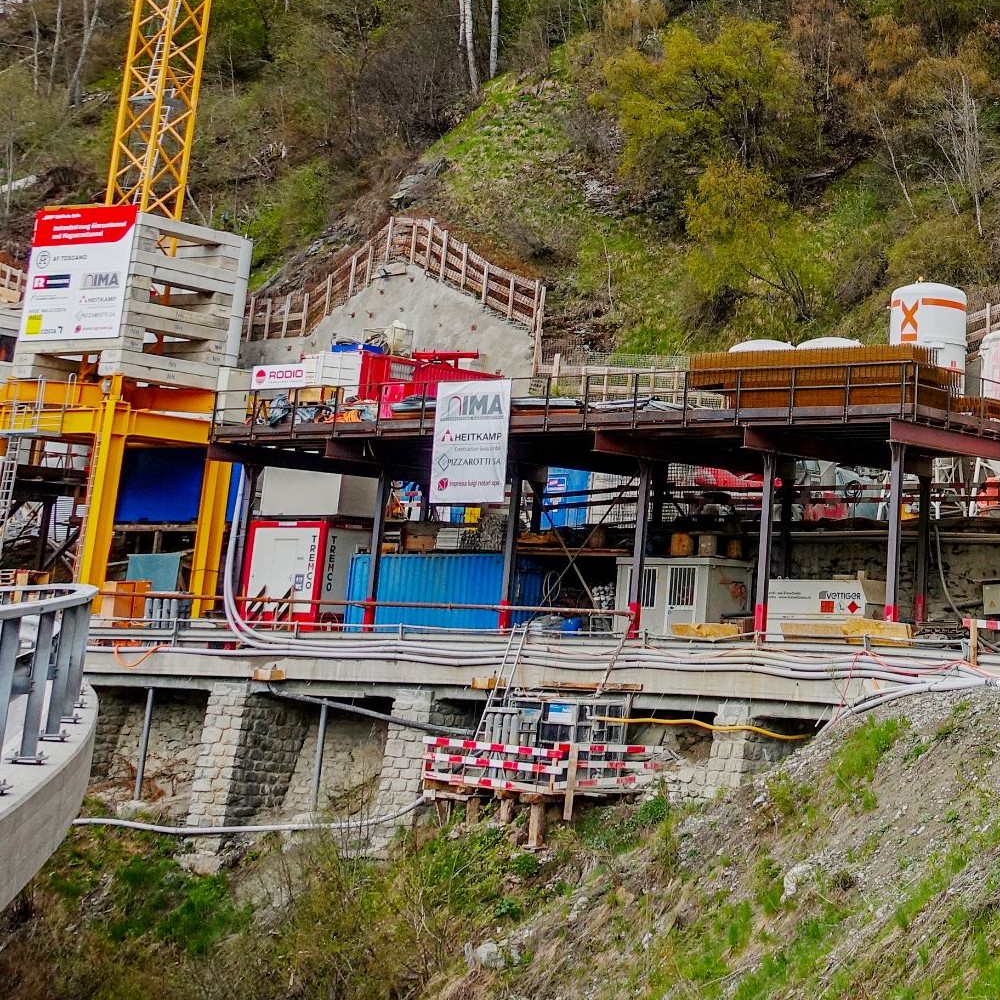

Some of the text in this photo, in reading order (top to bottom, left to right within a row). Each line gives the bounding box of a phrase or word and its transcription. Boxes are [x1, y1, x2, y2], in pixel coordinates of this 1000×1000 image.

[268, 368, 304, 380] RODIO
[454, 432, 502, 442] HEITKAMP
[448, 457, 501, 467] PIZZAROTTI SA
